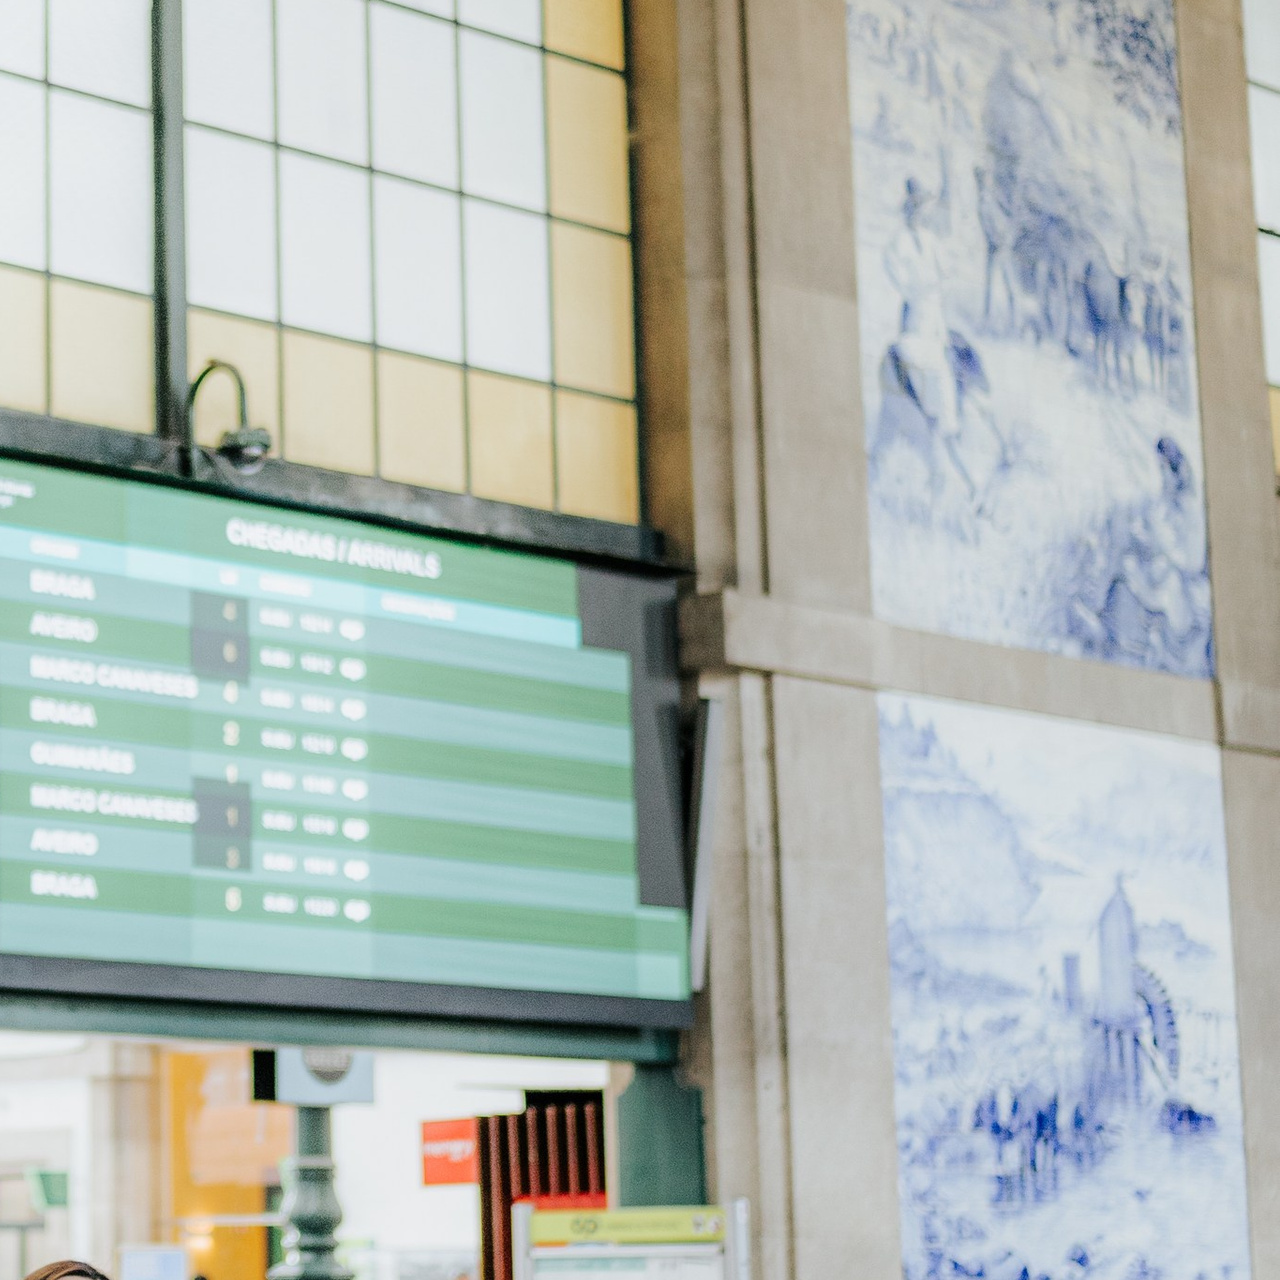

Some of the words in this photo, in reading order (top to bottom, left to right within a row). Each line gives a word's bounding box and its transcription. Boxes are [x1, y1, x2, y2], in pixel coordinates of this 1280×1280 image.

[225, 517, 337, 563] CHEGADAS
[348, 537, 443, 580] ARRIVALS
[29, 569, 97, 601] BRAGA
[30, 655, 96, 685] MARCO
[30, 697, 98, 728] BRAGA
[30, 785, 96, 812] MARCO
[30, 870, 99, 899] BRAGA
